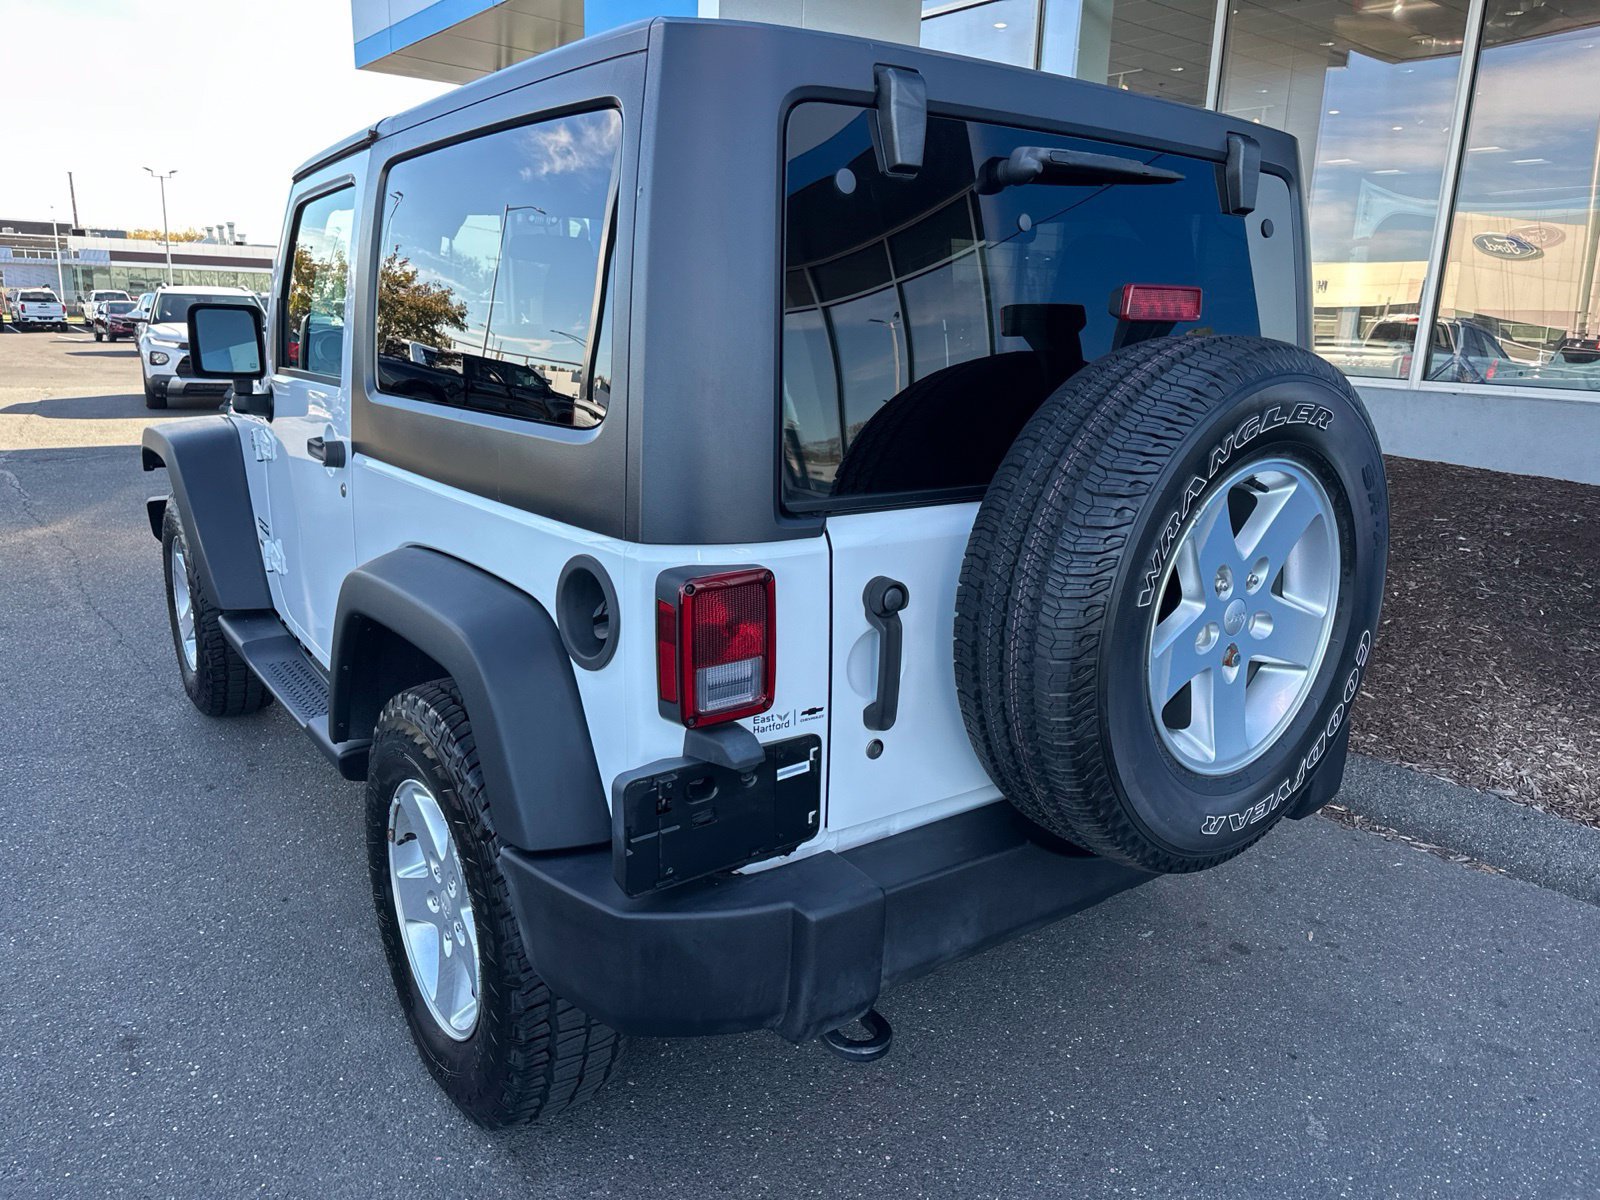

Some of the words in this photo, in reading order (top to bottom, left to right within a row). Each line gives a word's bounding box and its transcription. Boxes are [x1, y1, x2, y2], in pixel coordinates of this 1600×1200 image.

[1137, 403, 1335, 608] WRANGLER
[753, 714, 774, 724] East
[753, 720, 790, 734] Hartford
[1201, 629, 1372, 835] GOODYEAR
